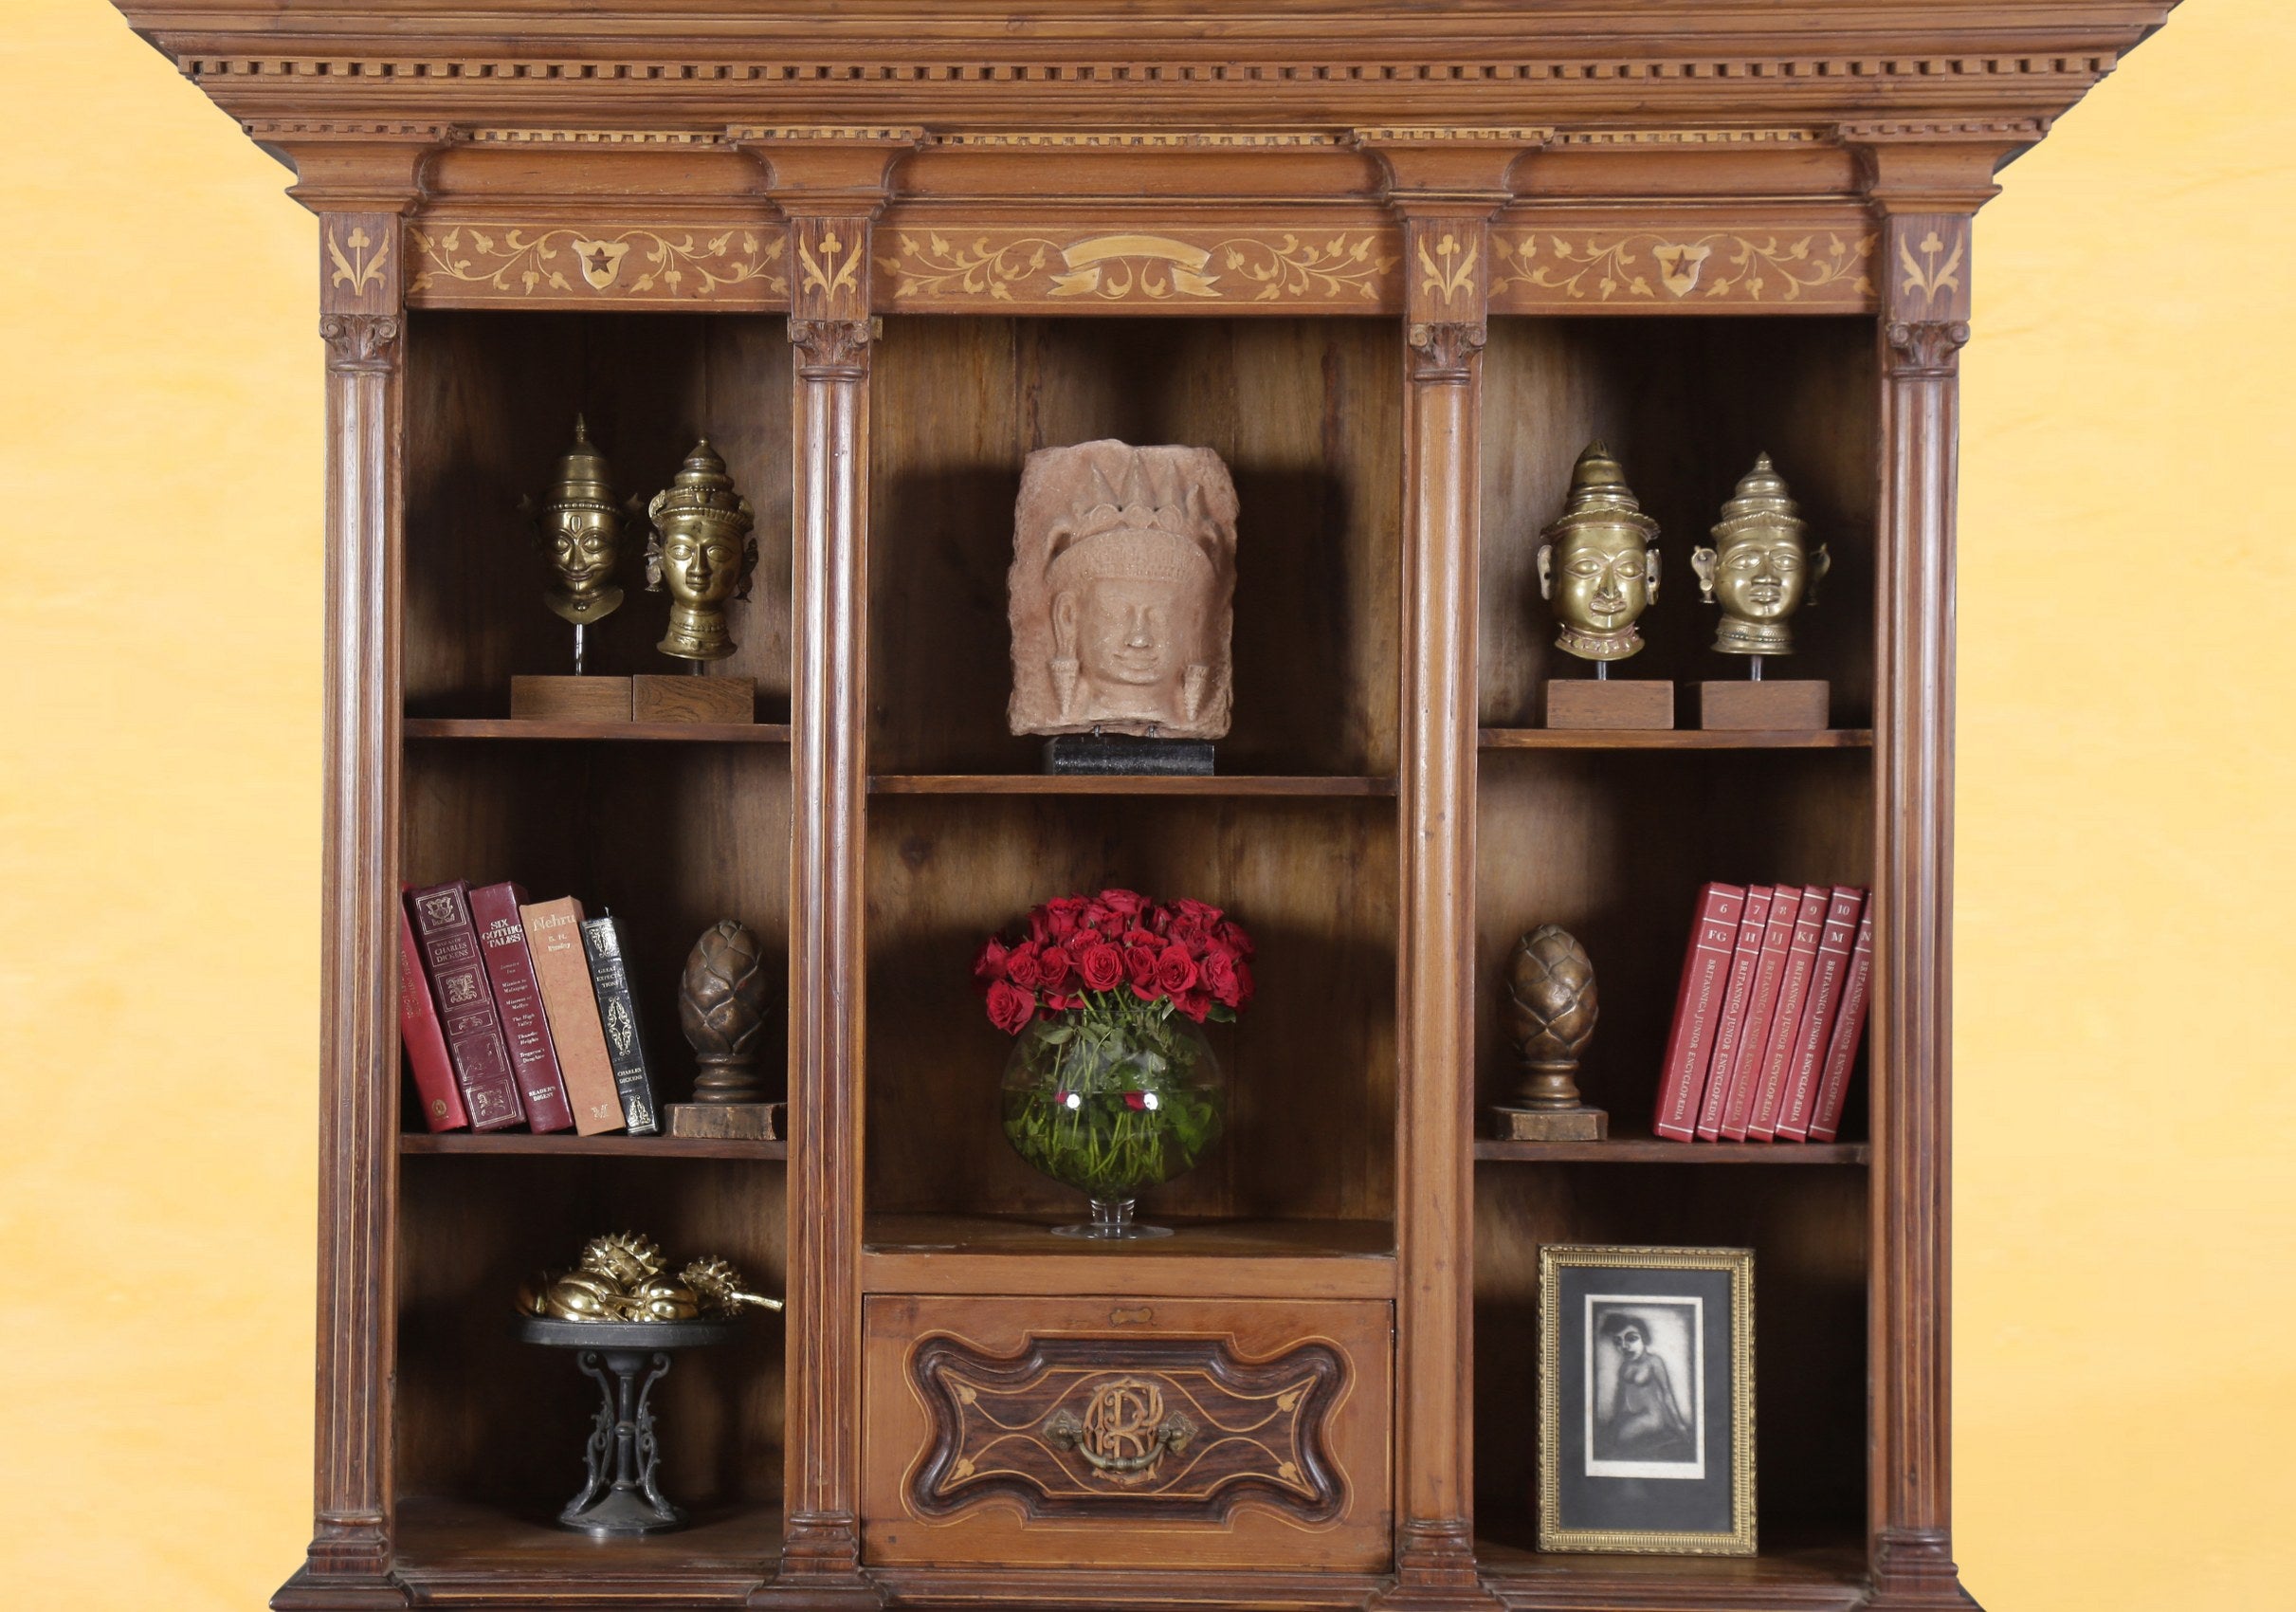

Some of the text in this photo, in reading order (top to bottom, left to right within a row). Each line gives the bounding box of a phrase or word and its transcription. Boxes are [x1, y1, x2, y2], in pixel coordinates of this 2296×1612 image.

[1720, 904, 1728, 913] 6
[1753, 905, 1761, 915] 7
[1779, 906, 1787, 915] 8
[1810, 906, 1817, 915] 9
[1837, 905, 1850, 916] 10
[490, 918, 509, 930] SIX
[532, 914, 576, 932] Nehru
[482, 924, 522, 941] GOTHIC
[1707, 929, 1727, 942] FG
[1745, 932, 1756, 943] H
[1796, 931, 1817, 944] KL
[1831, 931, 1844, 943] M
[1860, 931, 1871, 942] N
[487, 933, 521, 948] TALES
[434, 942, 467, 956] CHARLES
[436, 949, 469, 962] DICKENS
[1698, 959, 1716, 1013] BRITANNICA
[1729, 961, 1749, 1014] BRITANNICA
[1757, 961, 1775, 1014] BRITANNICA
[1785, 961, 1805, 1015] BRITANNICA
[1816, 960, 1836, 1015] BRITANNICA
[1849, 961, 1869, 1015] BRITANNICA
[1690, 1014, 1704, 1049] JUNIOR
[1722, 1015, 1737, 1050] JUNIOR
[1748, 1016, 1762, 1050] JUNIOR
[1777, 1016, 1792, 1051] JUNIOR
[1807, 1015, 1823, 1051] JUNIOR
[1840, 1015, 1855, 1051] JUNIOR
[617, 1068, 642, 1077] CHARLES
[619, 1074, 643, 1084] DICKENS
[528, 1086, 556, 1097] READER'S
[533, 1092, 554, 1102] DIGEST
